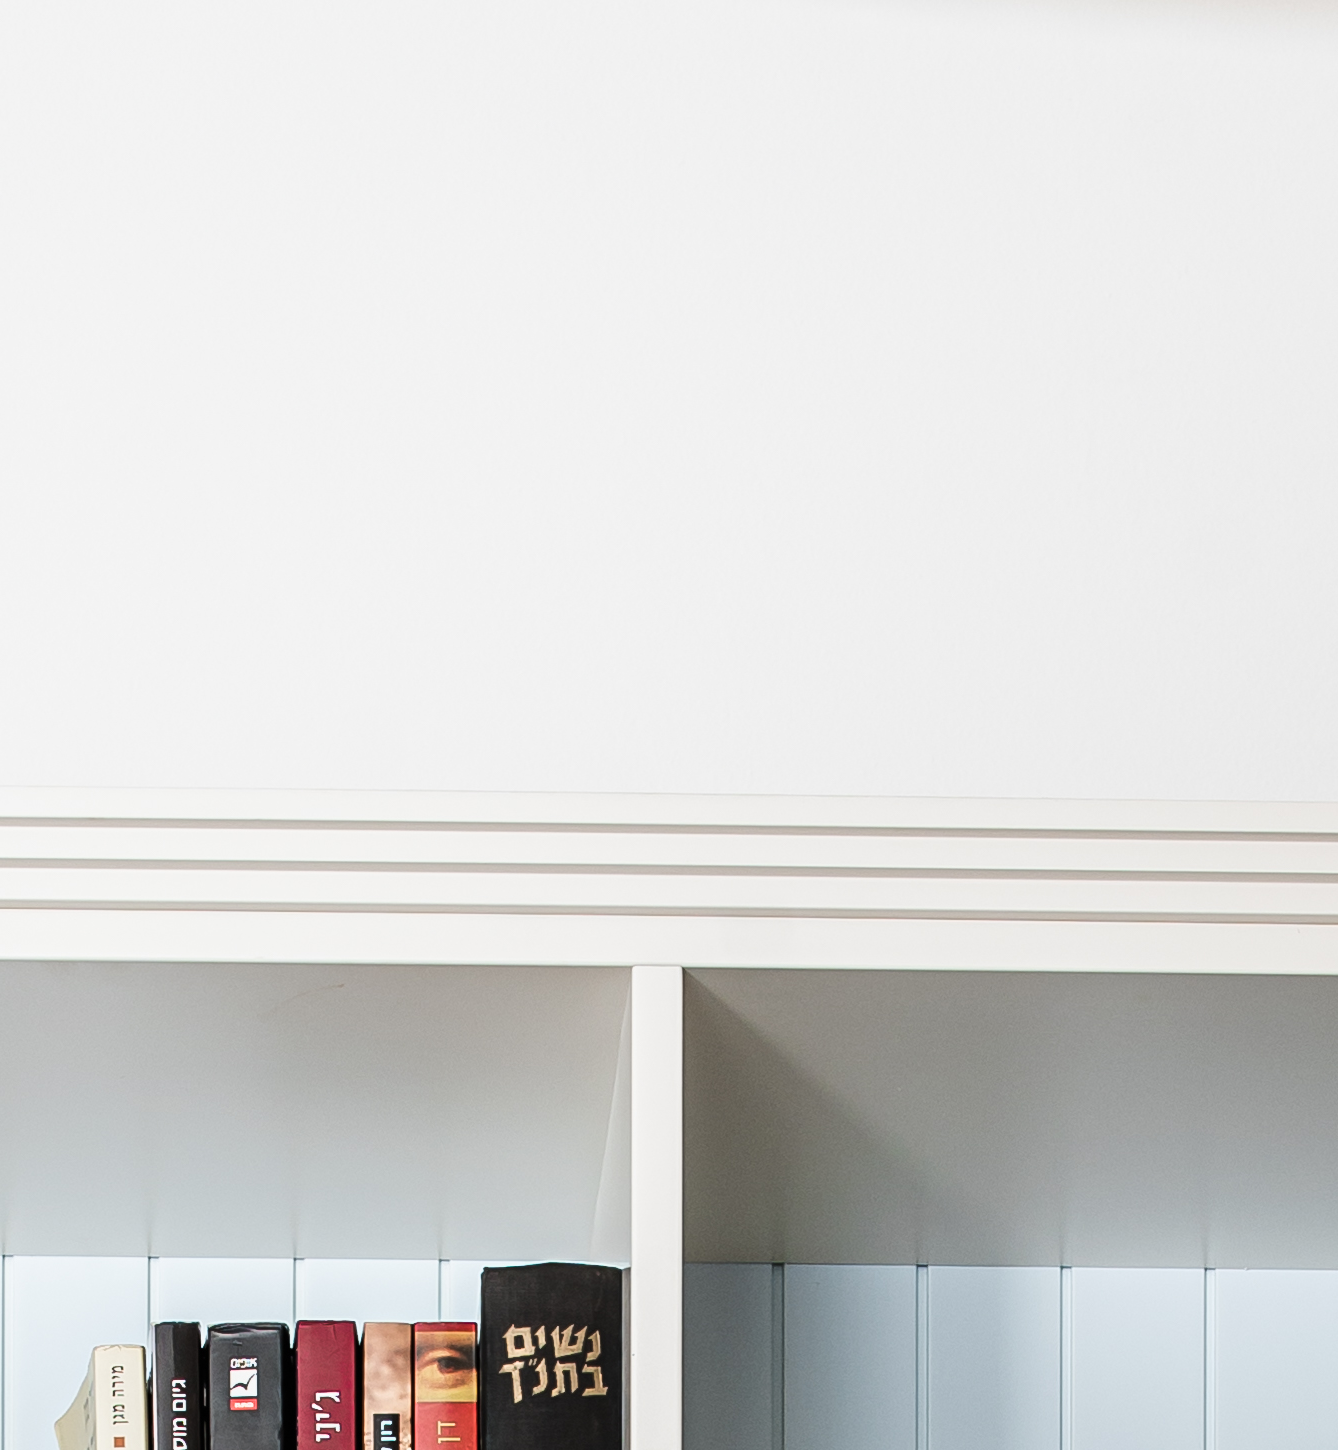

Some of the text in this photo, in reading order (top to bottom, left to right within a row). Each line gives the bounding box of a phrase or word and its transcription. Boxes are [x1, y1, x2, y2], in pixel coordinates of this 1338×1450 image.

[503, 1325, 603, 1361] נשים
[110, 1364, 129, 1425] מירה מגן
[171, 1379, 187, 1412] גיום
[379, 1420, 396, 1441] רון
[435, 1420, 459, 1442] דן
